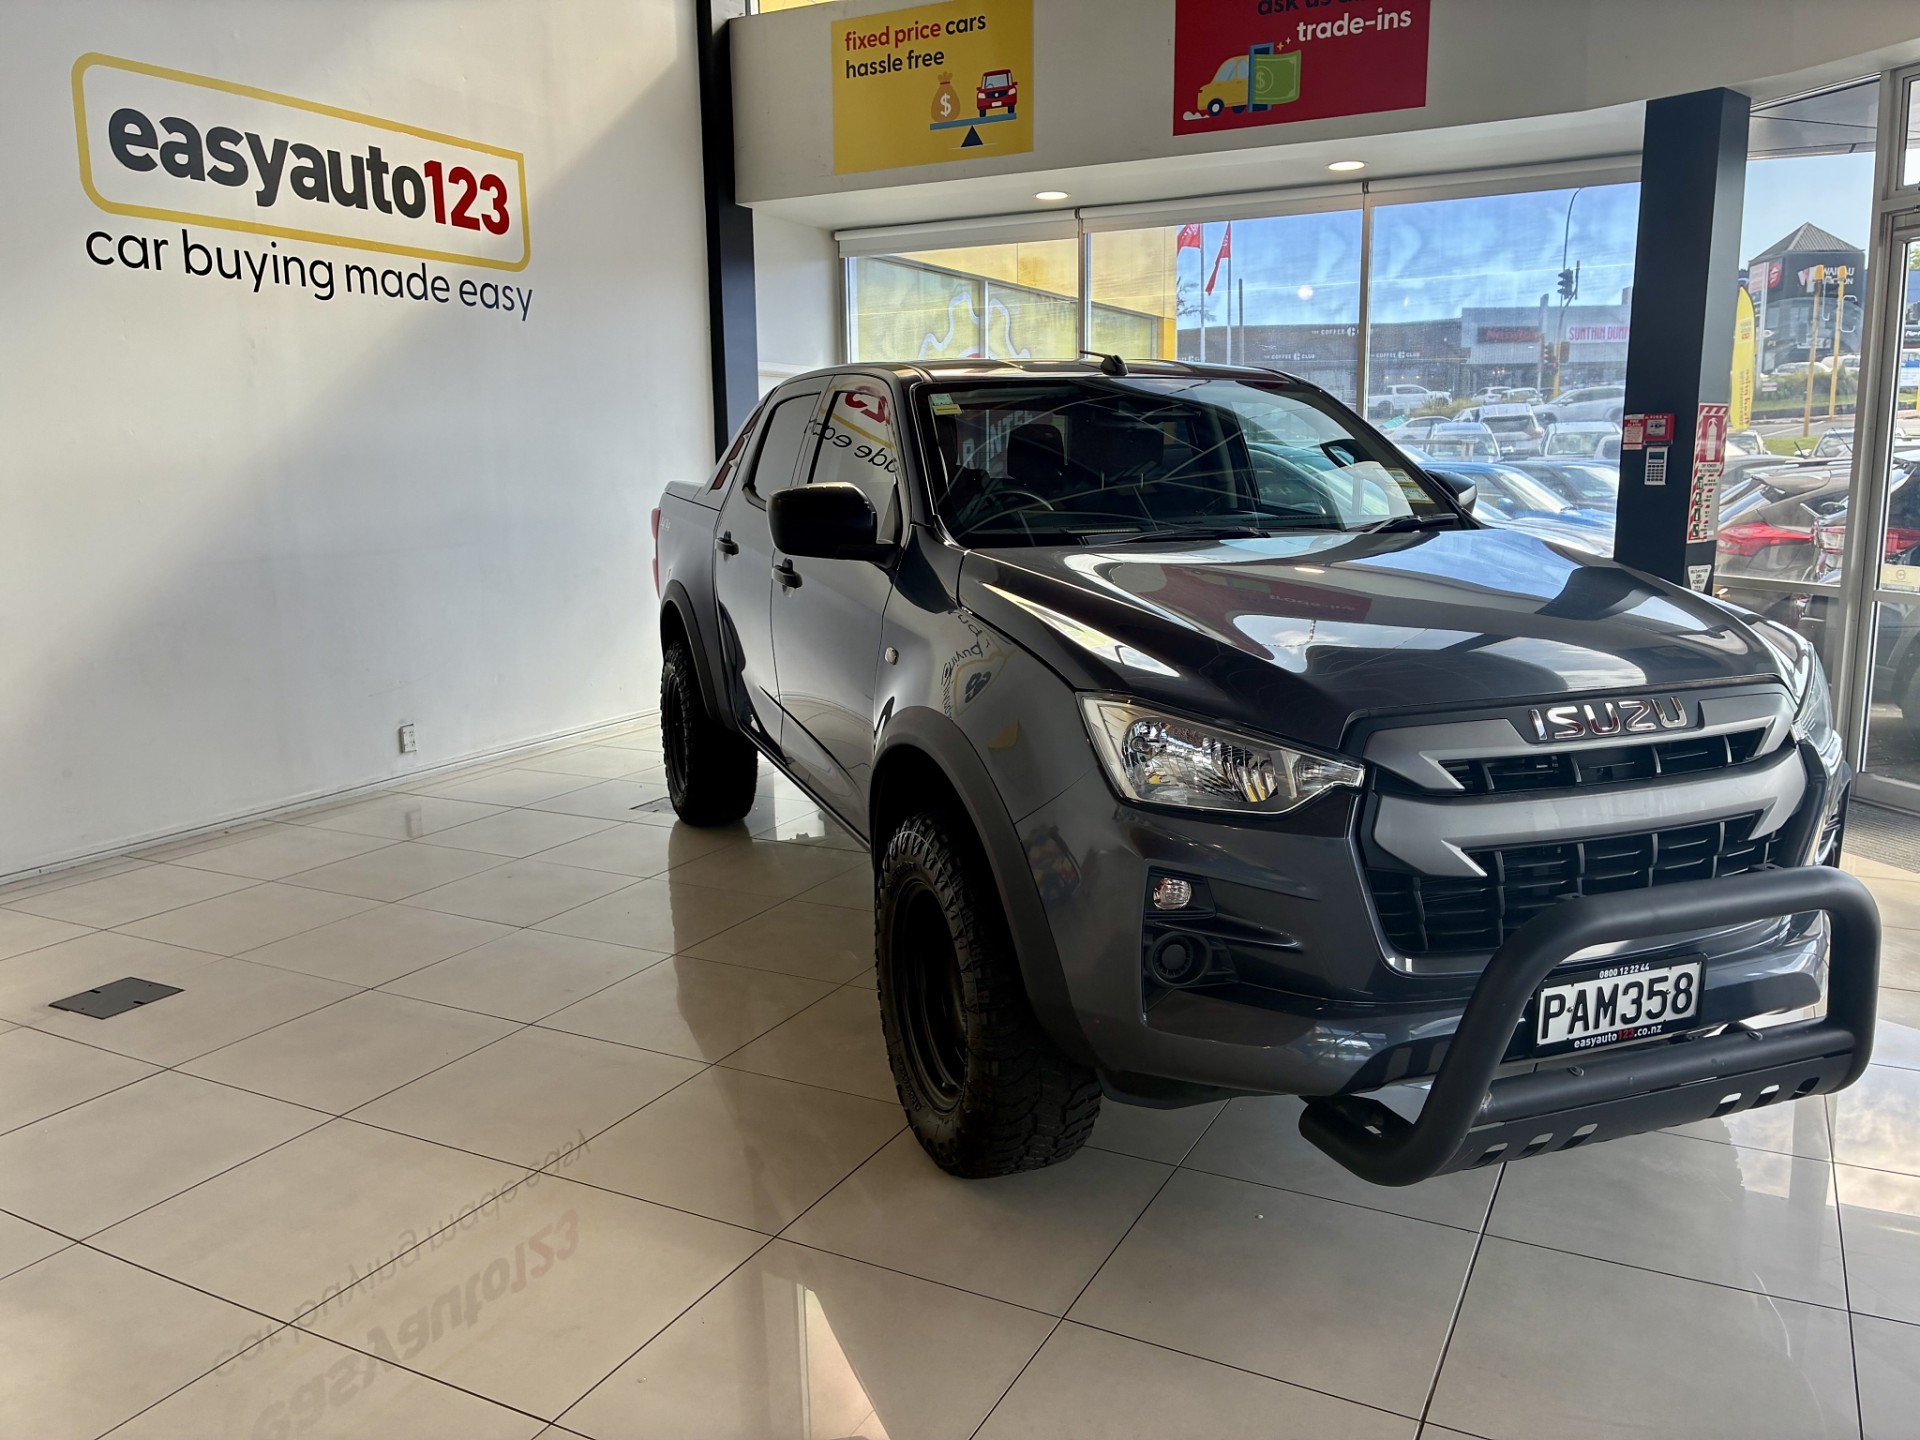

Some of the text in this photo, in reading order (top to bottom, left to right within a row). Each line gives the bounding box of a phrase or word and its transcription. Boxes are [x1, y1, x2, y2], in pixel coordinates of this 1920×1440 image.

[844, 13, 986, 52] fixed price cars
[1296, 7, 1412, 42] trade-ins
[845, 47, 945, 80] hassle free
[108, 107, 511, 236] easyauto123
[86, 228, 533, 321] car buying made easy
[1528, 696, 1688, 742] ISUZU
[1599, 962, 1650, 979] 0800 12 22 44
[1541, 971, 1694, 1040] PAM358
[1573, 1024, 1663, 1049] easyauto123.co.nz
